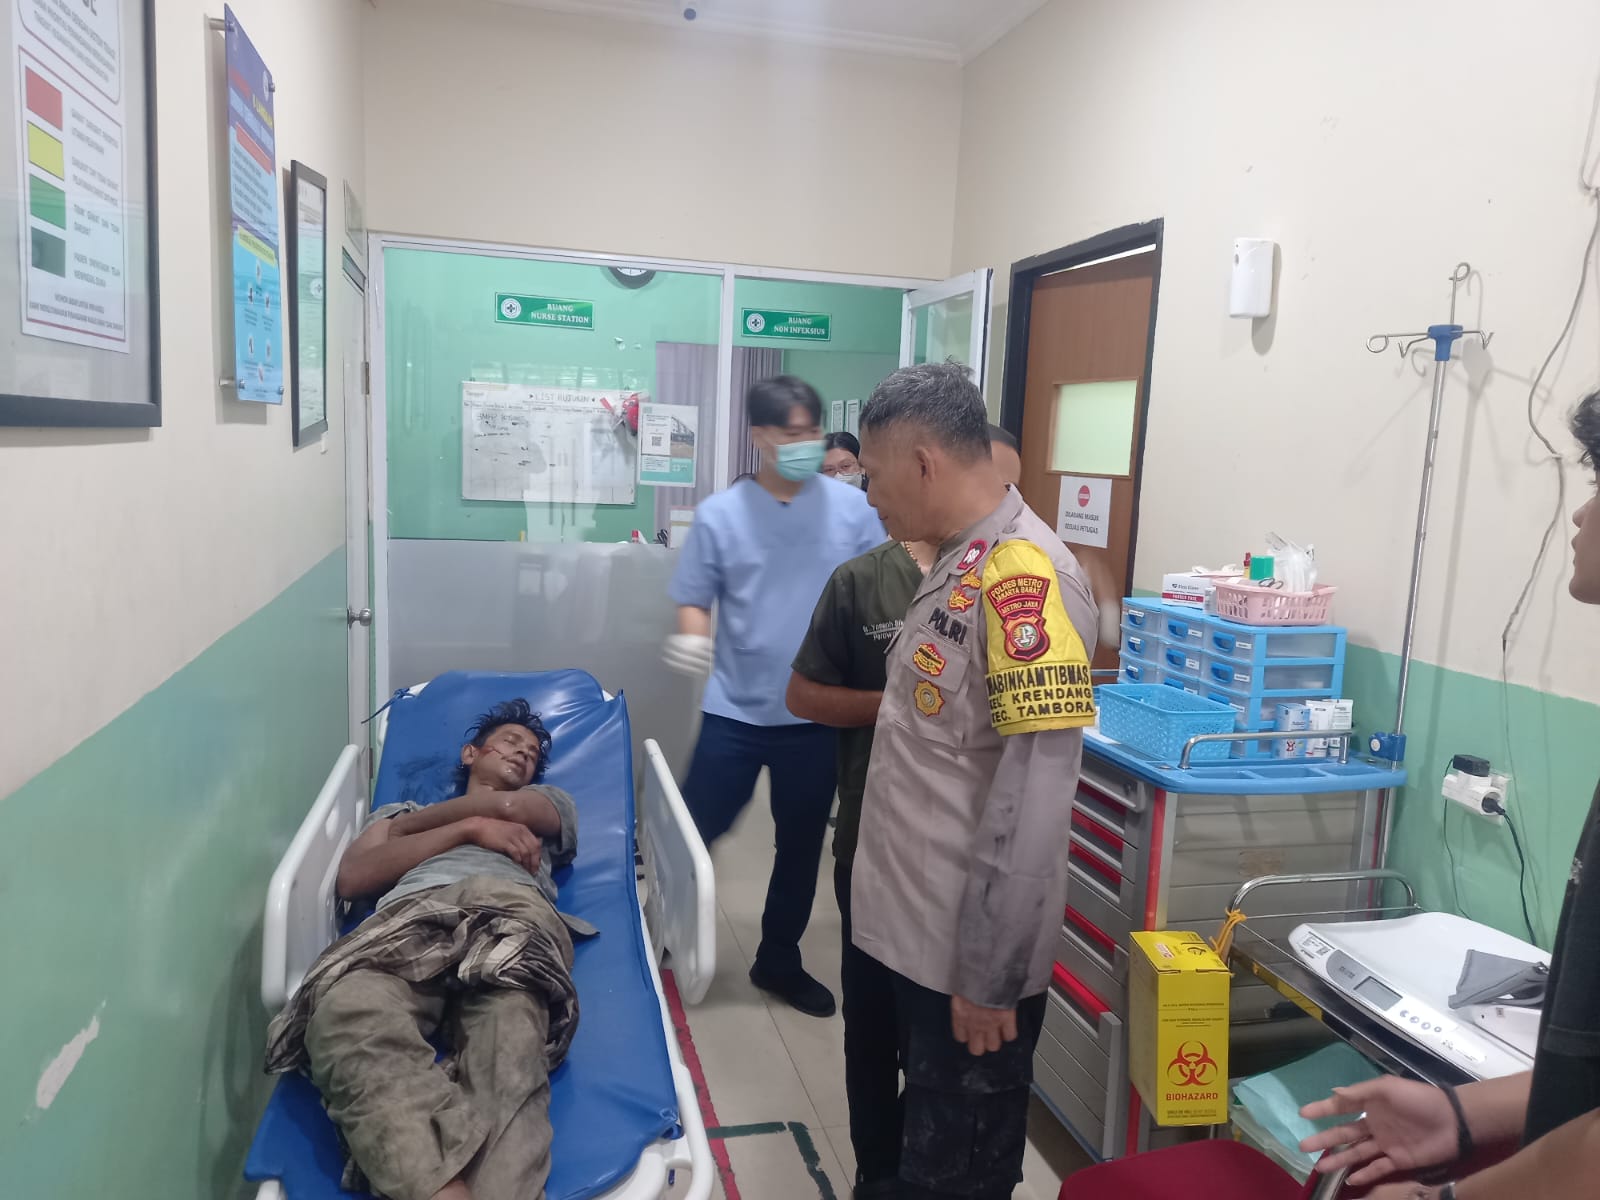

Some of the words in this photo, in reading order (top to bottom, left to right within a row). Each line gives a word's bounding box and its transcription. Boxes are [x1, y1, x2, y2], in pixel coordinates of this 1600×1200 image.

[547, 303, 574, 313] RUANG
[530, 311, 557, 321] NURSE
[557, 314, 589, 324] STATION
[788, 316, 812, 325] RUANG
[774, 325, 789, 333] NON
[789, 326, 825, 335] INFEKSIUS
[535, 392, 555, 401] LIST
[991, 579, 1016, 598] POLRES
[1017, 578, 1043, 588] METRO
[1020, 586, 1042, 595] BARAT
[1001, 601, 1022, 614] METRO
[1023, 600, 1039, 609] JAYA
[928, 607, 967, 645] POLRI
[1012, 688, 1092, 704] KRENDANG
[1016, 701, 1094, 718] TAMBORA
[1166, 1092, 1218, 1101] BIOHAZARD
